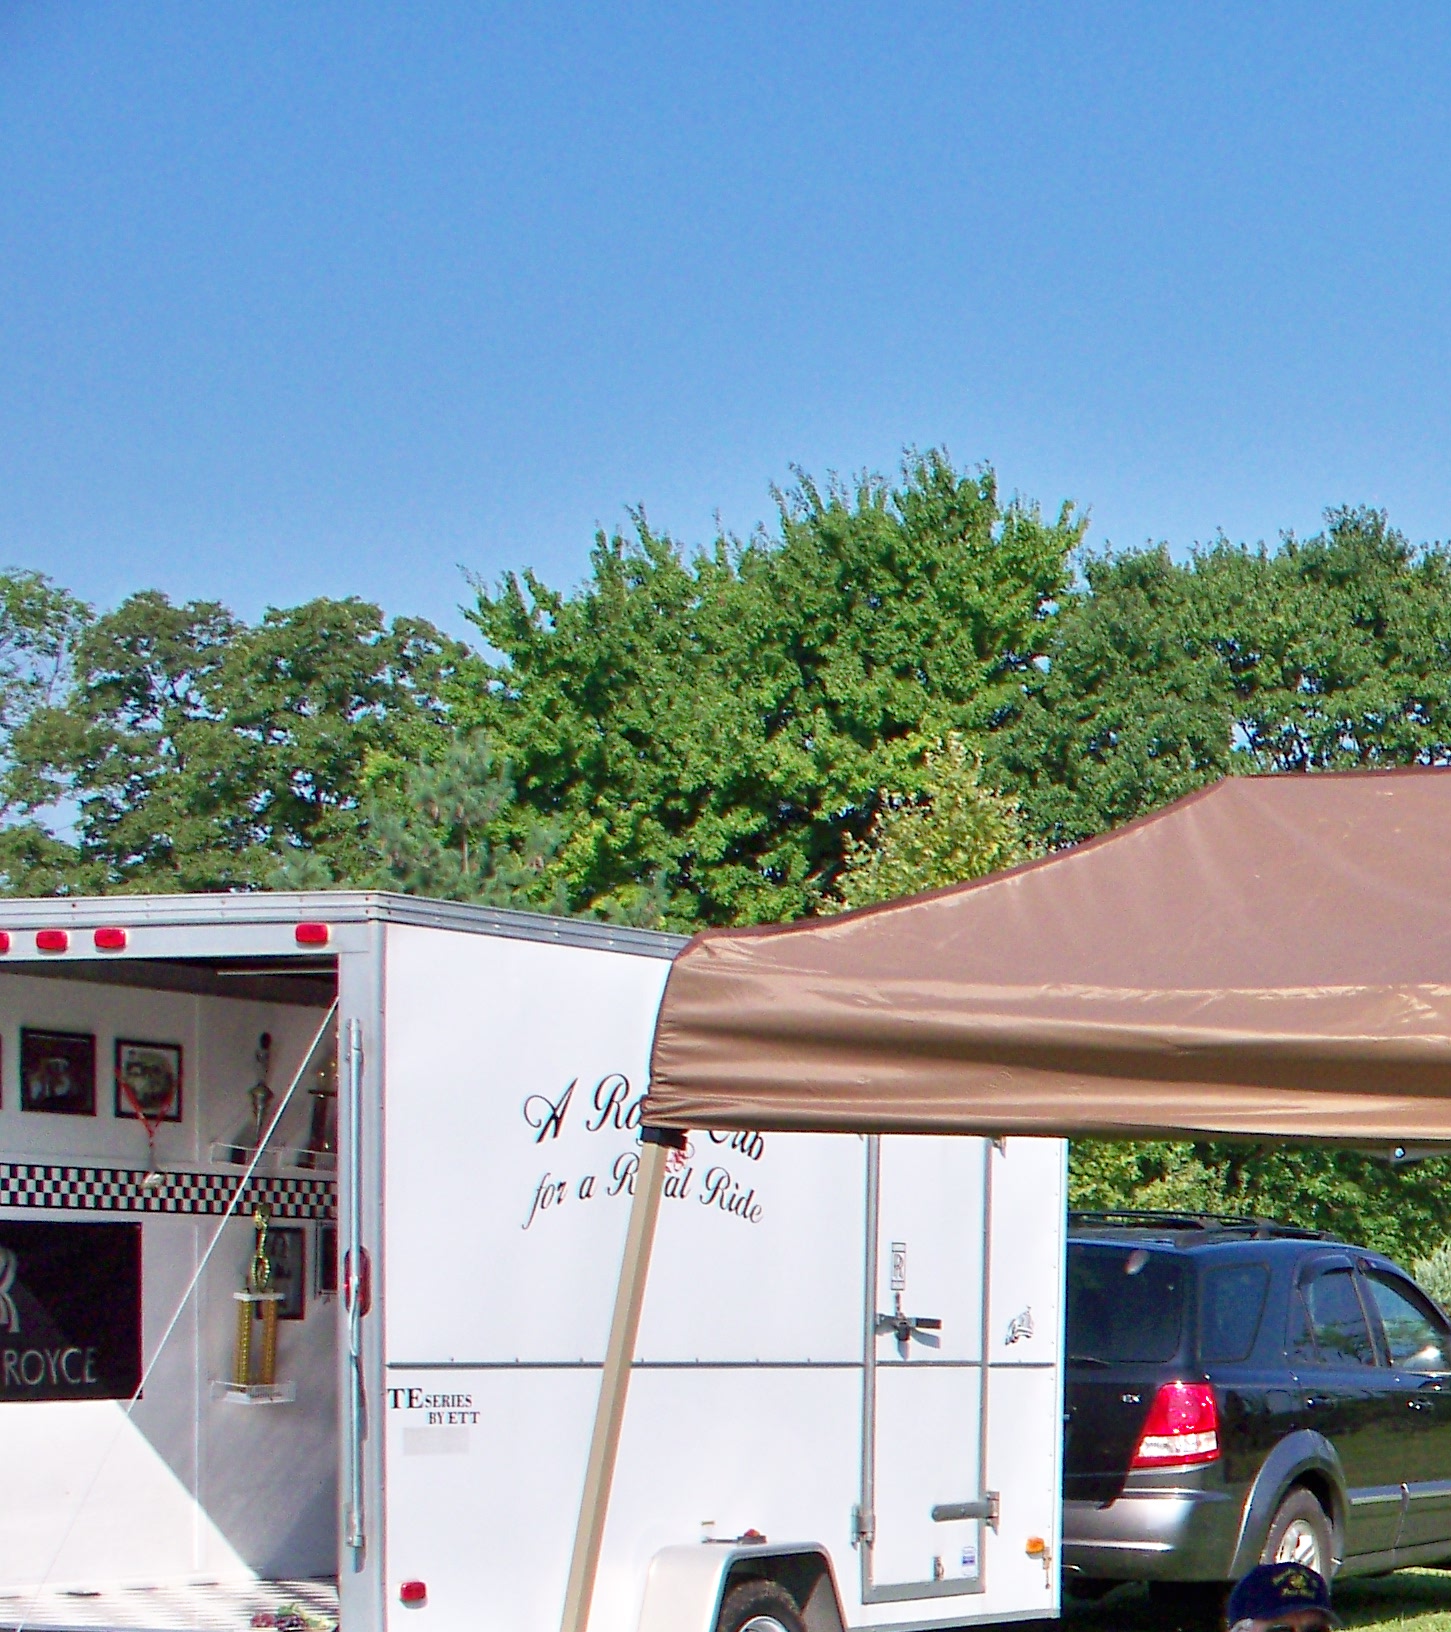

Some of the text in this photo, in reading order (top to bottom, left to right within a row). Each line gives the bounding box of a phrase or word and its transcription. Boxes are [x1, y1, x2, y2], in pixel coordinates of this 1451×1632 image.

[523, 1077, 579, 1143] A
[522, 1152, 763, 1229] for a Ral Ride
[4, 1348, 98, 1386] ROYCE
[387, 1387, 473, 1409] TE SERIES
[429, 1411, 480, 1424] BY ETT
